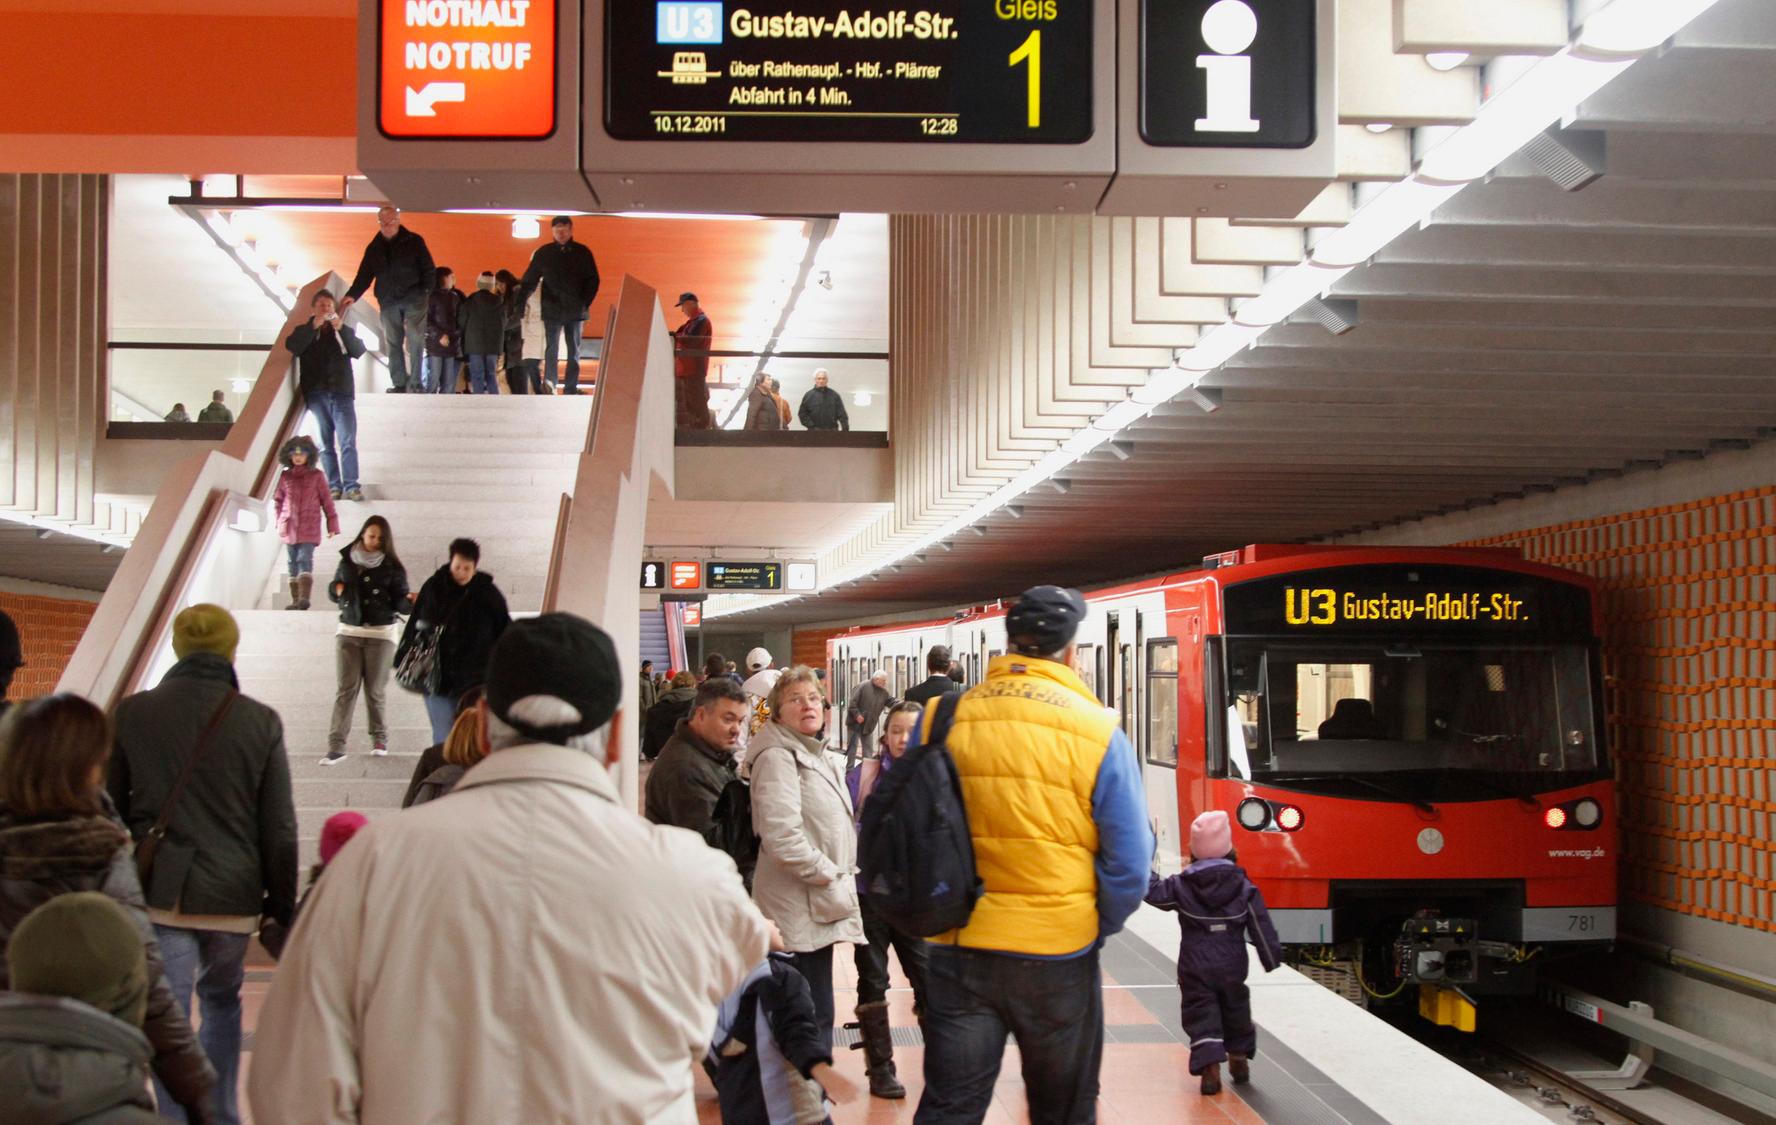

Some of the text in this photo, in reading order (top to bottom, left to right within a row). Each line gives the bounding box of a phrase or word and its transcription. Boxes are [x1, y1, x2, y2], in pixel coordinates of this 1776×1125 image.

[405, 0, 530, 27] NOTHALT
[995, 0, 1058, 20] Gleis
[729, 9, 959, 39] Gustav-Adolf-Str.
[405, 41, 532, 70] NOTRUF
[729, 60, 761, 78] über
[763, 61, 843, 81] Rathenaupl.
[855, 63, 883, 79] Hbf.
[895, 62, 942, 79] Plärrer
[1009, 29, 1041, 128] 1
[728, 86, 852, 105] Abfahrt in 4 Min.
[654, 116, 958, 135] 10.12.2011 12:28
[767, 570, 775, 588] 1
[1285, 588, 1530, 625] U3 Gustav-Adolf-Str.
[1548, 846, 1605, 860] www.vag.de
[1568, 914, 1595, 932] 781
